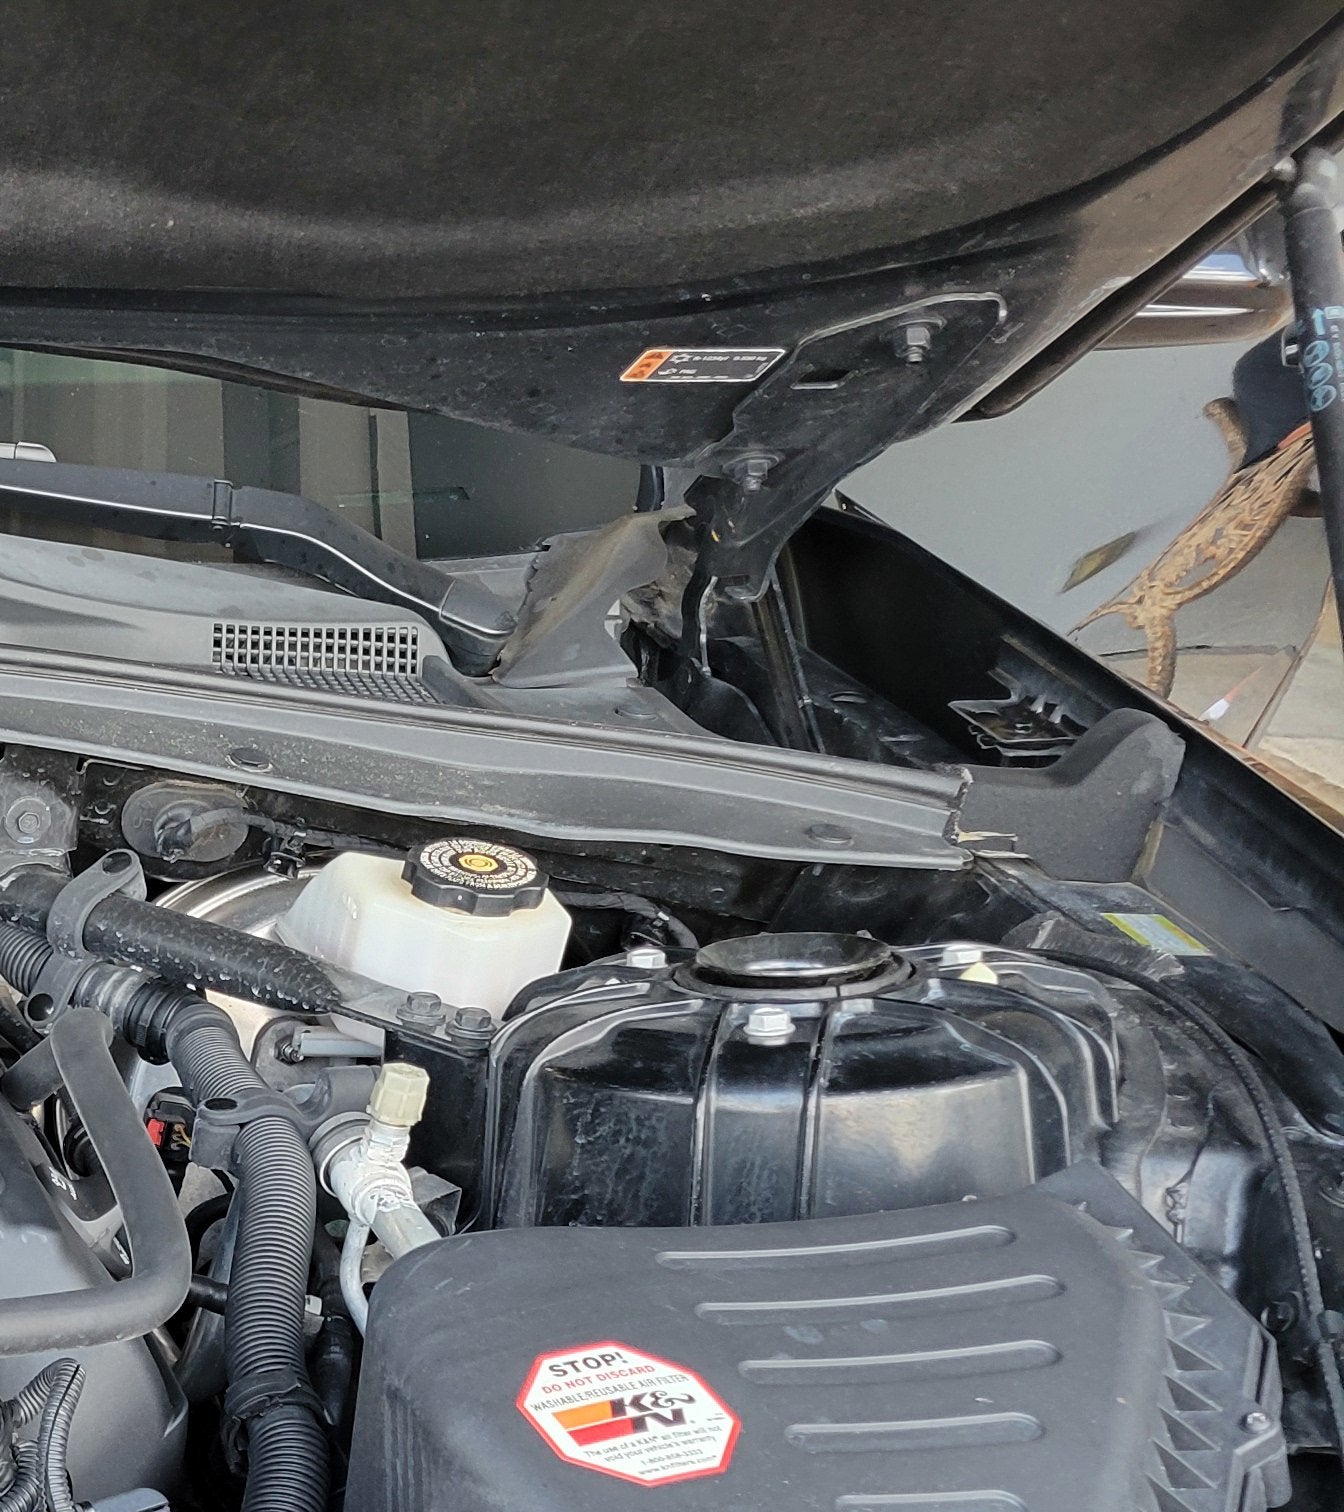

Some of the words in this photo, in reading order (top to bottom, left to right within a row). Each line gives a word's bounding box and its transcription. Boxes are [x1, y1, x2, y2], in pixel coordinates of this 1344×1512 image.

[548, 1351, 628, 1378] STOP!
[541, 1383, 562, 1394] DO
[566, 1376, 594, 1389] NOT
[598, 1365, 655, 1381] DISCARD
[638, 1377, 656, 1390] AIR
[657, 1374, 690, 1386] FILTER
